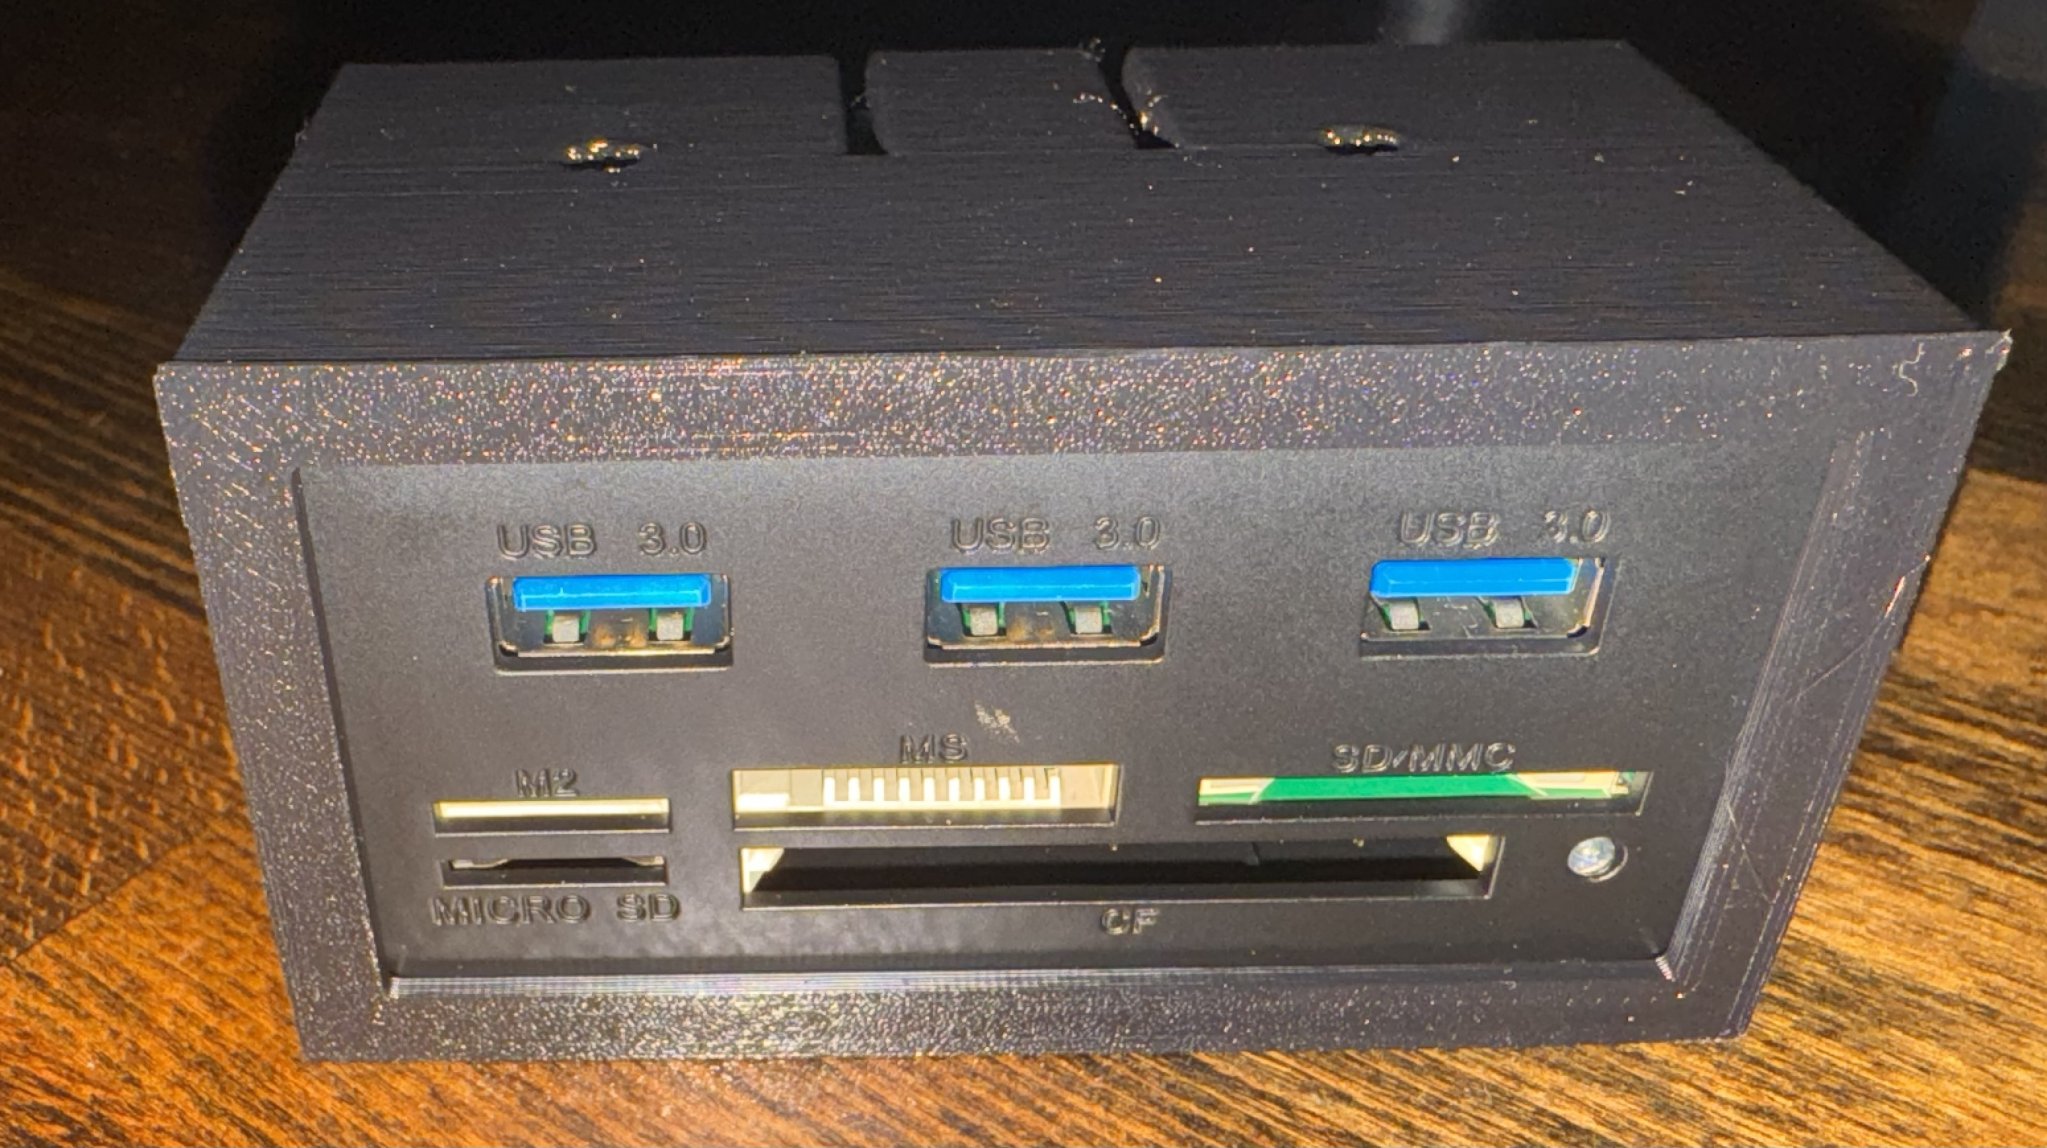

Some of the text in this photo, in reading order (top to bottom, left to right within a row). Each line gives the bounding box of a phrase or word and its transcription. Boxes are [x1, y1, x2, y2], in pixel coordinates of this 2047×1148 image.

[498, 521, 708, 559] USB 3.0
[952, 516, 1161, 554] USB 3.0
[1400, 510, 1500, 548] USB
[899, 733, 969, 764] MS
[1332, 742, 1516, 774] SD/MMC
[514, 768, 578, 798] M2
[430, 892, 681, 926] MICRO SD
[1100, 907, 1161, 936] CF
